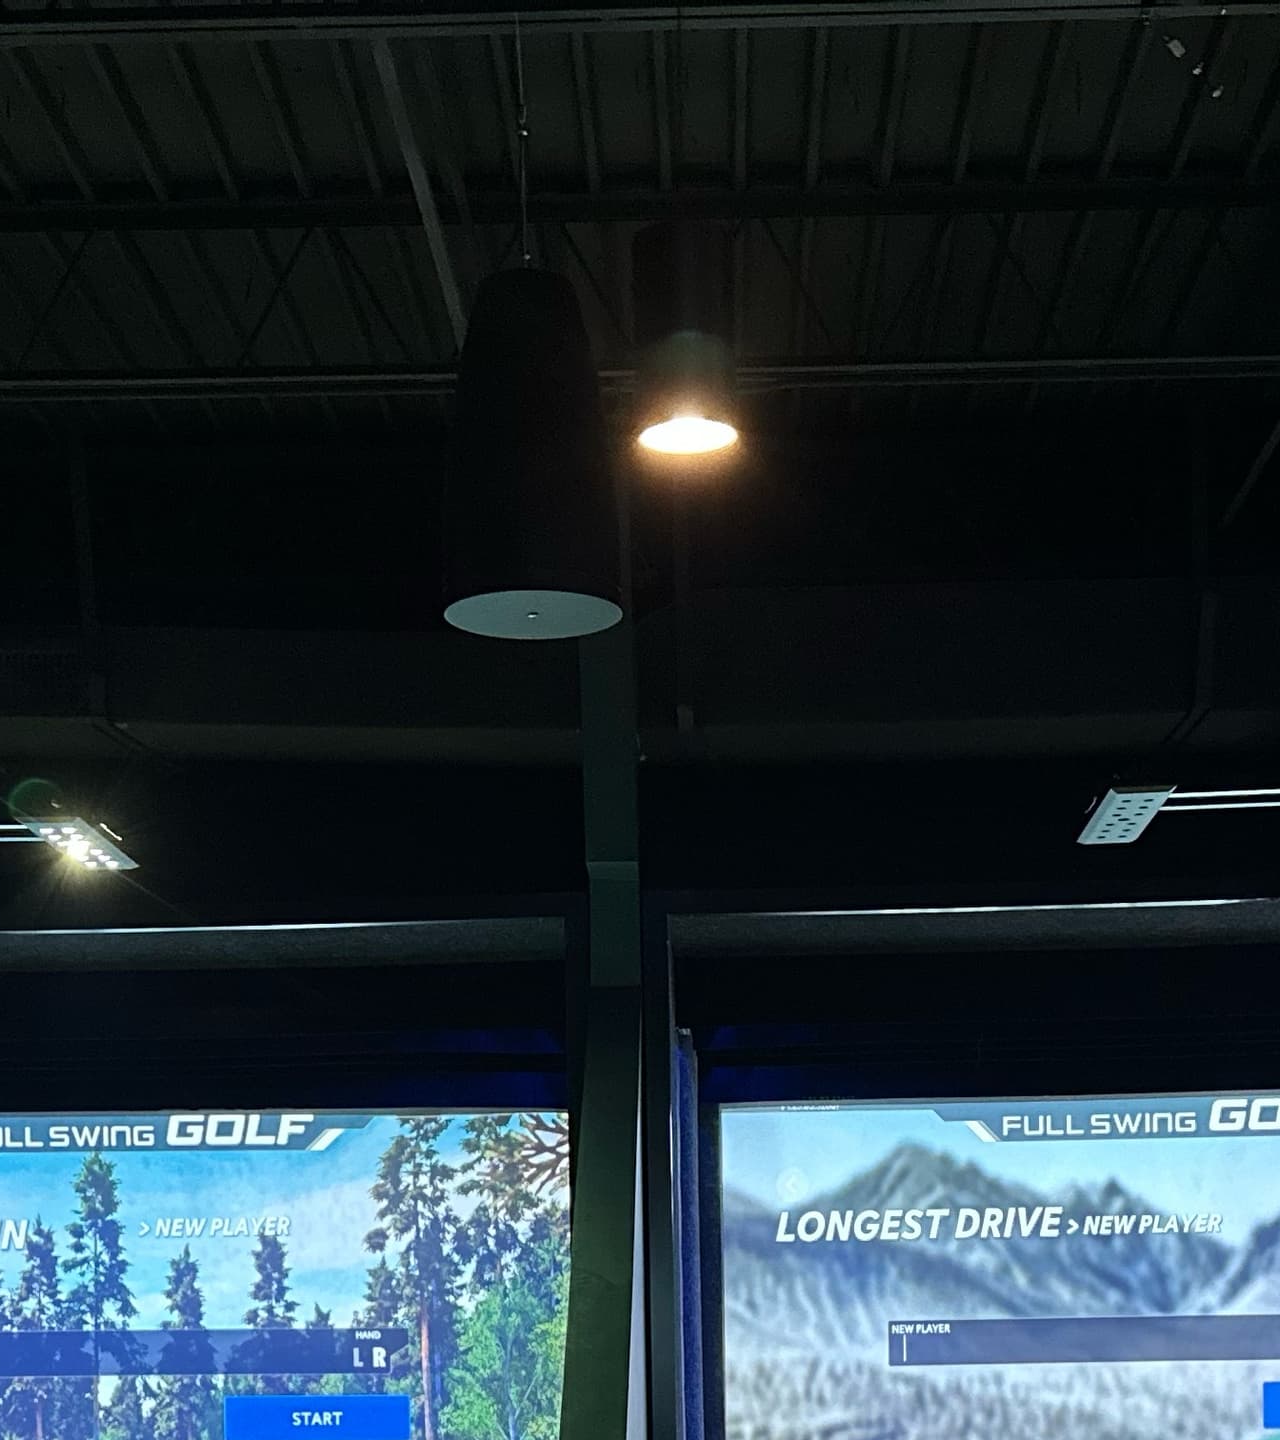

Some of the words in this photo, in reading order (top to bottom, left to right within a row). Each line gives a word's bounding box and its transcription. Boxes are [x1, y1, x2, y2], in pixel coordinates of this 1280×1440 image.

[49, 1125, 155, 1149] SWING
[166, 1113, 314, 1146] GOLF
[1002, 1114, 1084, 1137] FULL
[1090, 1111, 1196, 1136] SWING
[155, 1217, 207, 1238] NEW
[209, 1215, 291, 1237] PLAYER
[775, 1207, 950, 1242] LONGEST
[954, 1206, 1063, 1239] DRIVE
[1083, 1214, 1136, 1236] NEW
[1138, 1212, 1224, 1235] PLAYER
[355, 1330, 381, 1340] HAND
[891, 1324, 915, 1335] NEW
[915, 1322, 951, 1334] PLAYER
[353, 1347, 364, 1367] L
[372, 1346, 387, 1368] R
[292, 1411, 343, 1426] START
